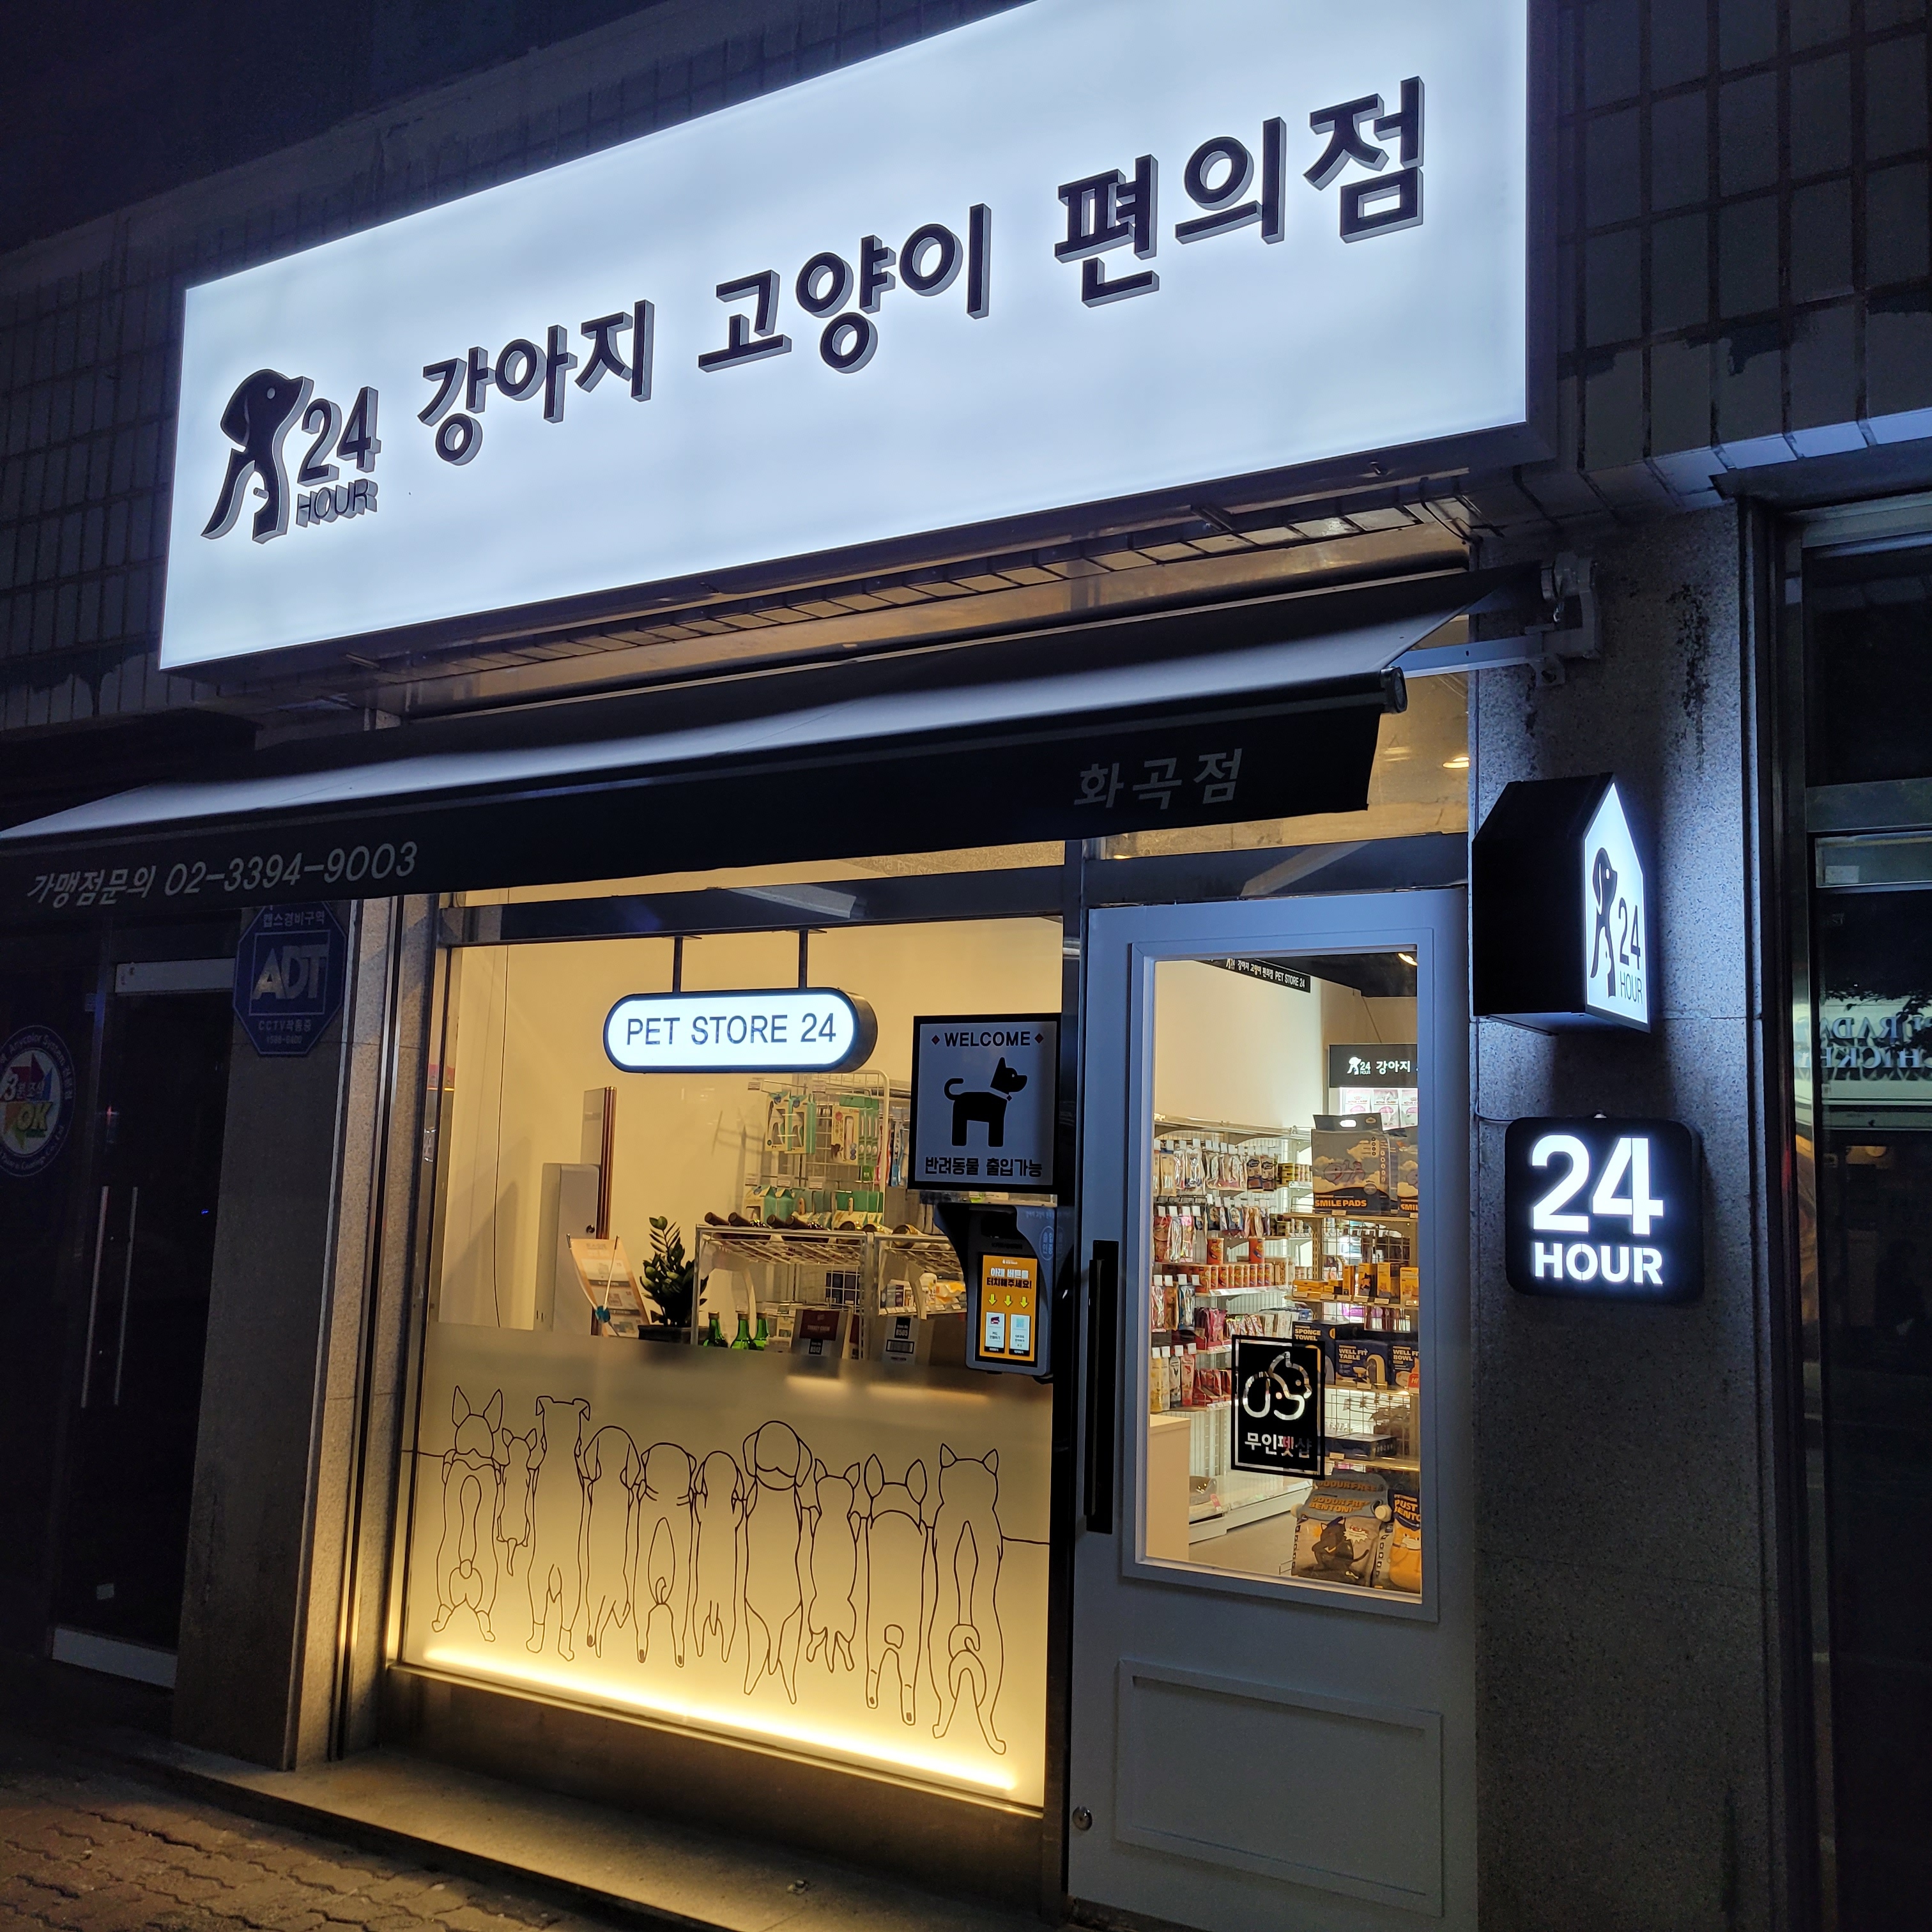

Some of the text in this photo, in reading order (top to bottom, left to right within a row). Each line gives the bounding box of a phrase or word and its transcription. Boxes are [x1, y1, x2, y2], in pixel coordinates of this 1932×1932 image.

[417, 76, 1424, 466] 강아지 고양이 편의점
[297, 387, 381, 486] 24
[296, 479, 378, 528] HOUR
[1073, 748, 1243, 809] 화곡점
[26, 841, 418, 909] 가맹점문의 02-3394-9003
[1619, 897, 1641, 970] 24
[251, 944, 330, 1000] ADT
[1275, 970, 1284, 982] PET
[1284, 973, 1300, 986] STORE
[1299, 977, 1306, 988] 24
[1620, 970, 1643, 1004] HOUR
[627, 1013, 836, 1045] PET STORE 24
[944, 1031, 1031, 1047] WELCOME
[1360, 1061, 1371, 1071] 24
[1376, 1060, 1411, 1075] 강아지
[17, 1101, 53, 1131] OK
[924, 1156, 1043, 1178] 반려동물 출입가능
[1531, 1133, 1664, 1236] 24
[1315, 1199, 1342, 1208] SMILE
[990, 1267, 1029, 1280] 아래 버튼을
[1533, 1241, 1664, 1285] HOUR
[986, 1276, 1032, 1289] 터치해주세요!
[1294, 1328, 1322, 1336] SPONGE
[1244, 1432, 1312, 1459] 무인펫샵
